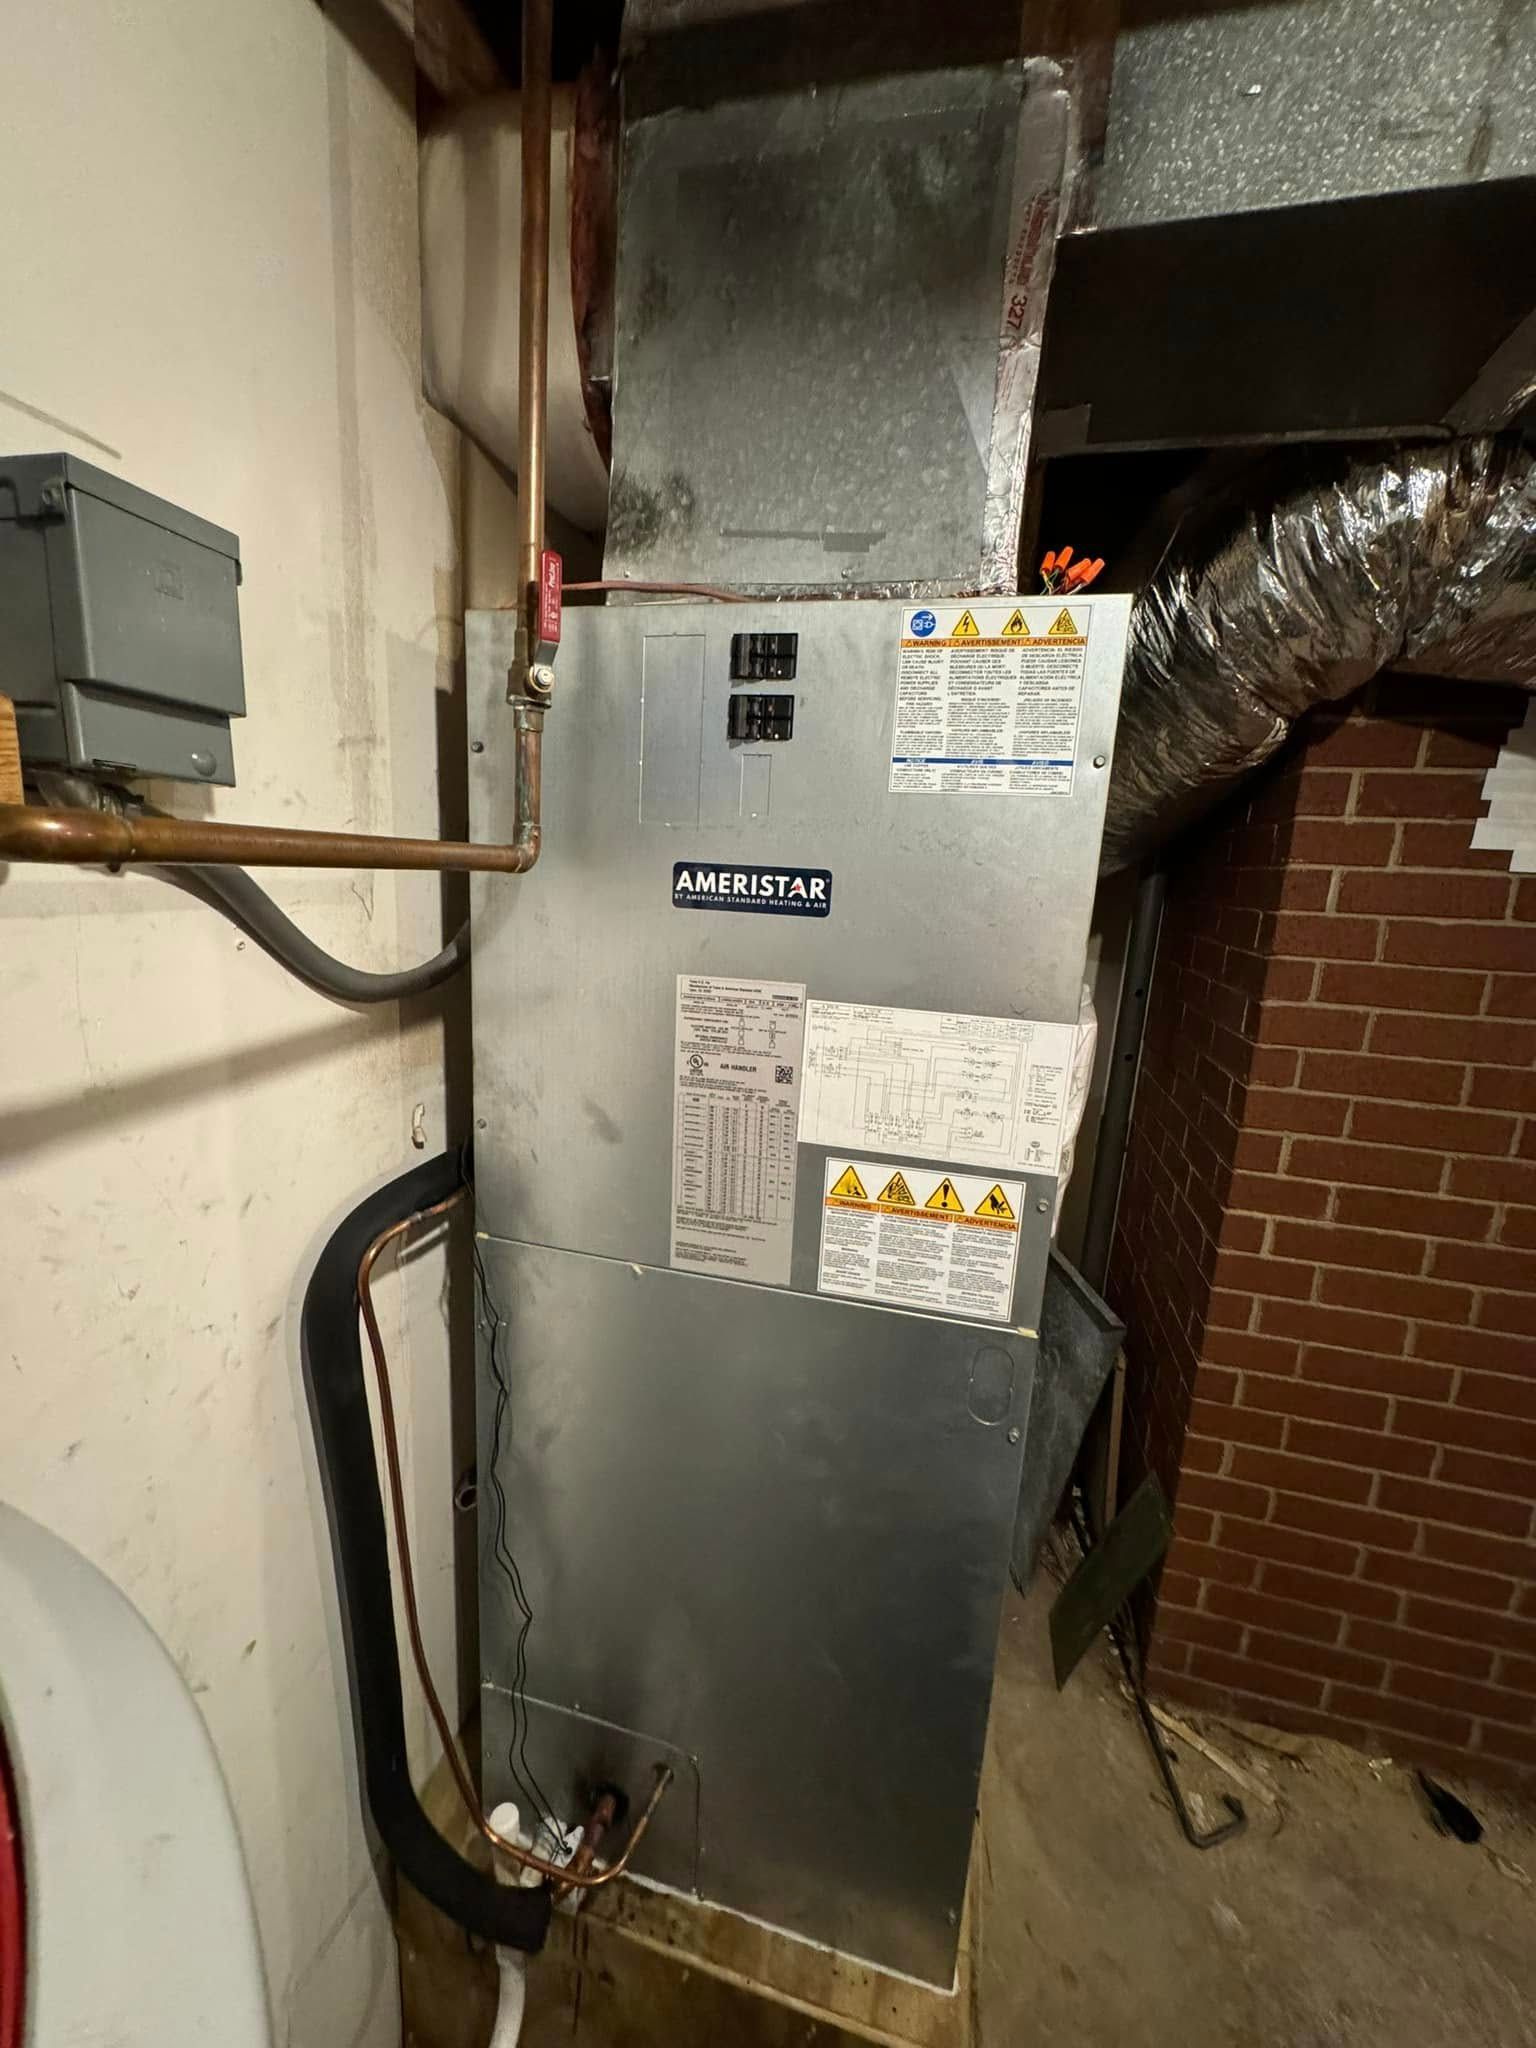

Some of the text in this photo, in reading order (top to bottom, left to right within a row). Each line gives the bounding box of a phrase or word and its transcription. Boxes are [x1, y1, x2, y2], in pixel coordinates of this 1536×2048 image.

[1006, 295, 1028, 331] 327
[912, 639, 947, 647] WARNING
[960, 638, 1021, 647] AVERTISSEMENT
[1031, 637, 1085, 647] ADVERTENCIA
[675, 870, 827, 900] AMERISTAR
[686, 894, 724, 902] AMERICAN
[727, 896, 766, 905] STANDARD
[769, 899, 802, 908] HEATING
[731, 1064, 757, 1072] HANDLER
